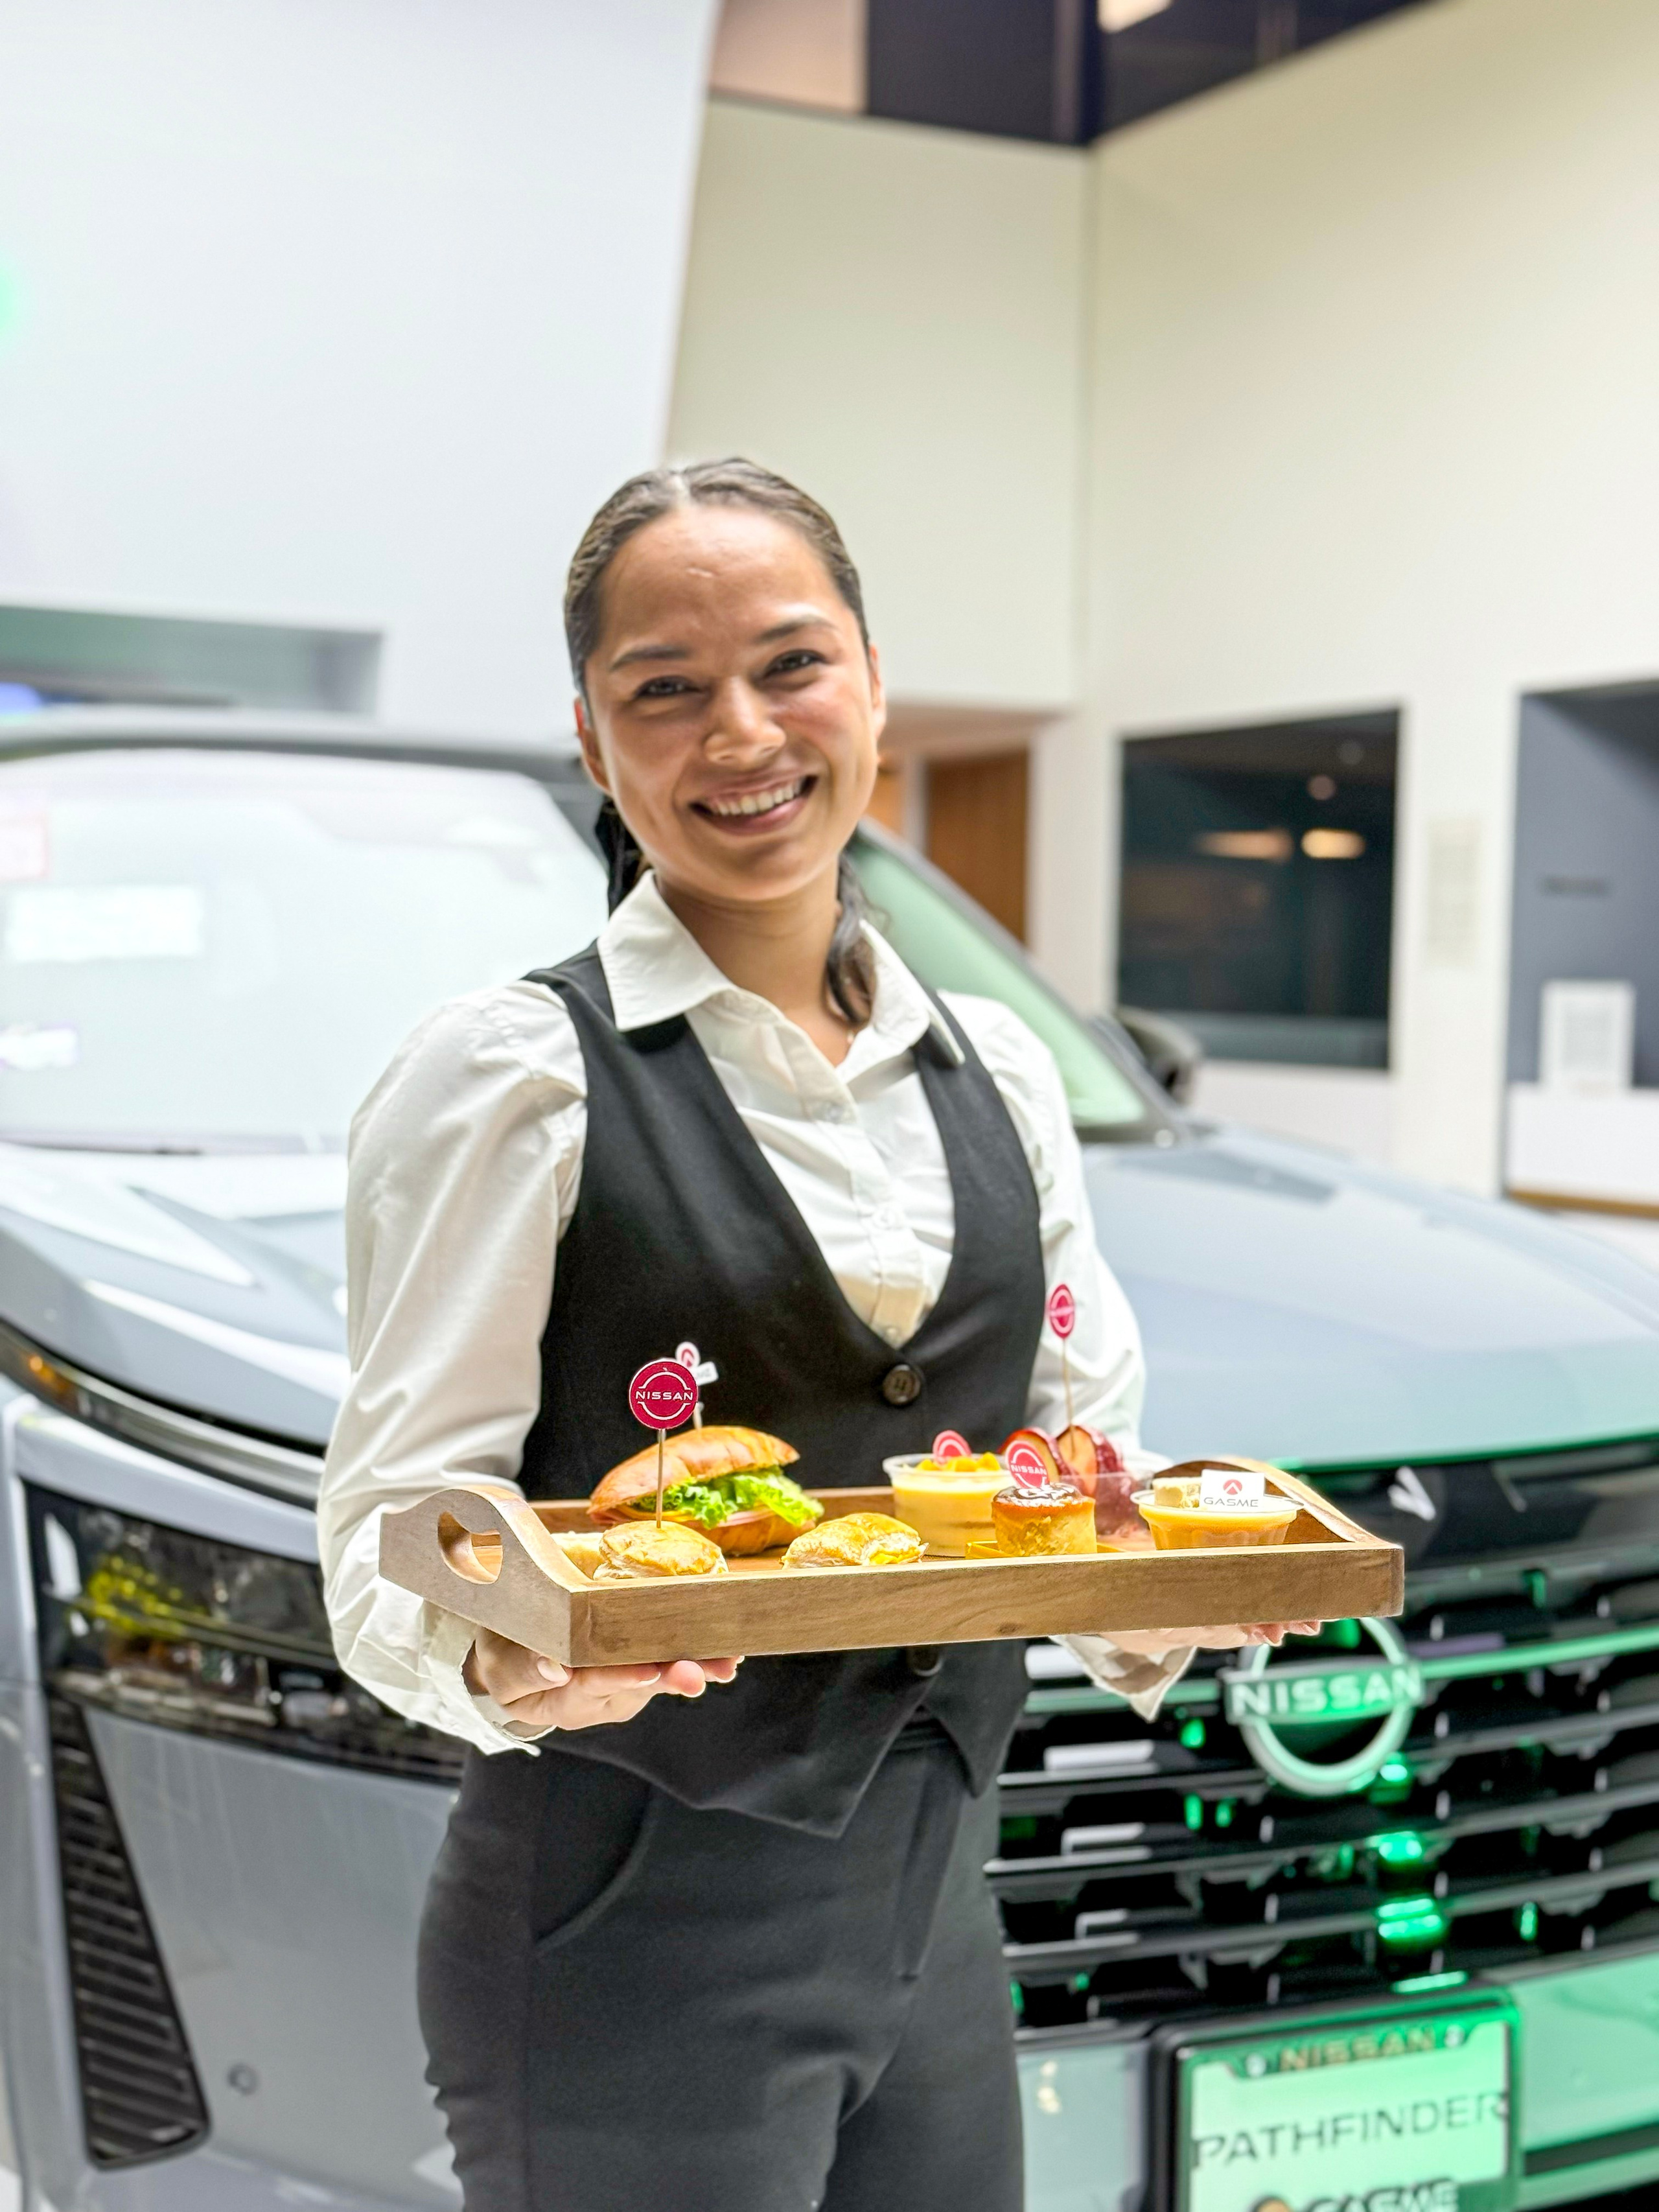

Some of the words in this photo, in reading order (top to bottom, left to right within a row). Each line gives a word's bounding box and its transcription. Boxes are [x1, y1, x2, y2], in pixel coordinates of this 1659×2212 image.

[635, 1390, 693, 1401] NISSAN
[1010, 1463, 1047, 1475] NISSAN
[1203, 1497, 1259, 1508] GASME
[1233, 1668, 1421, 1716] NISSAN
[1279, 2025, 1435, 2073] NISSAN
[1191, 2091, 1508, 2169] PATHFINDER
